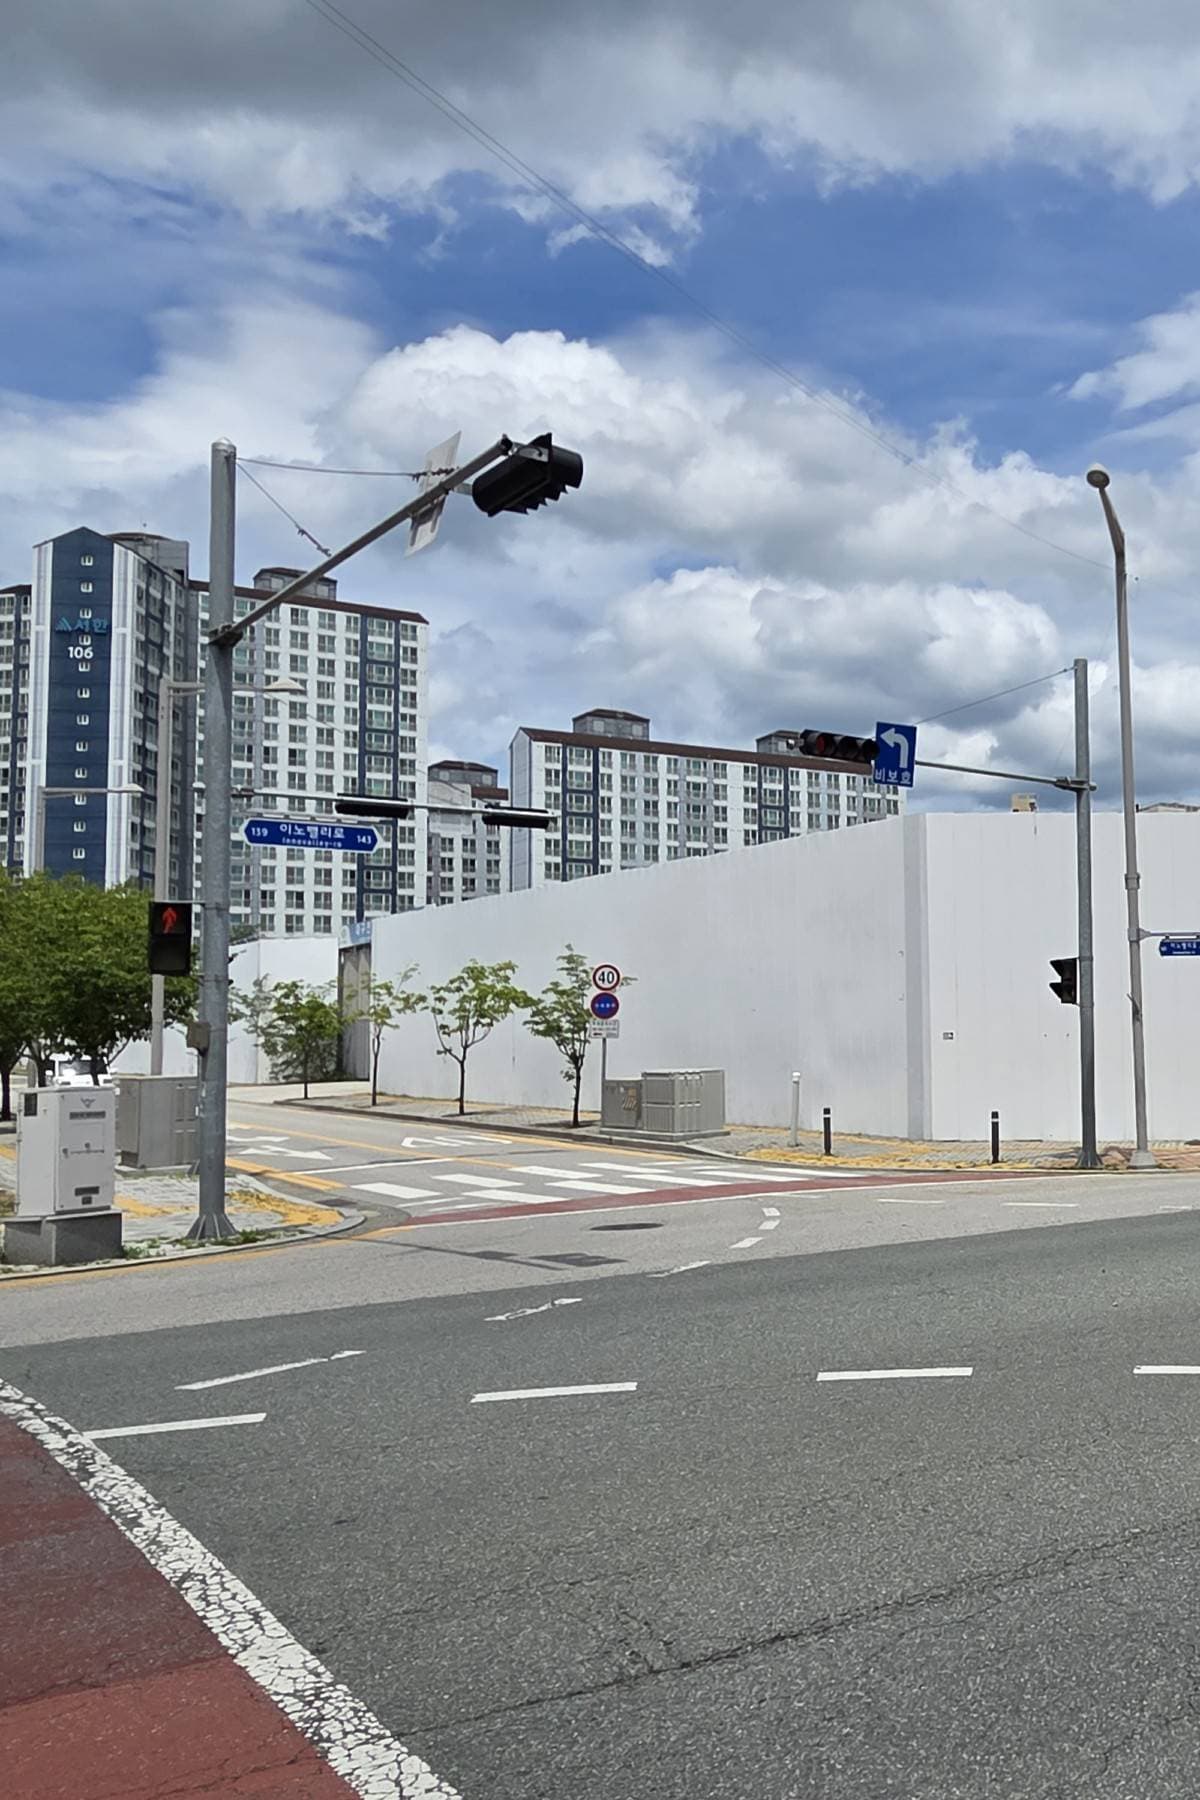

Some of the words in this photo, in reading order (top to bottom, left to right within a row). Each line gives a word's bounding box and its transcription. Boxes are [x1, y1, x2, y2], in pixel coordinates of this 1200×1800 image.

[67, 646, 94, 659] 106
[875, 767, 911, 785] 비보호
[251, 827, 269, 837] 139
[279, 823, 345, 839] 이노밸리로
[356, 835, 372, 845] 143
[598, 971, 615, 984] 40
